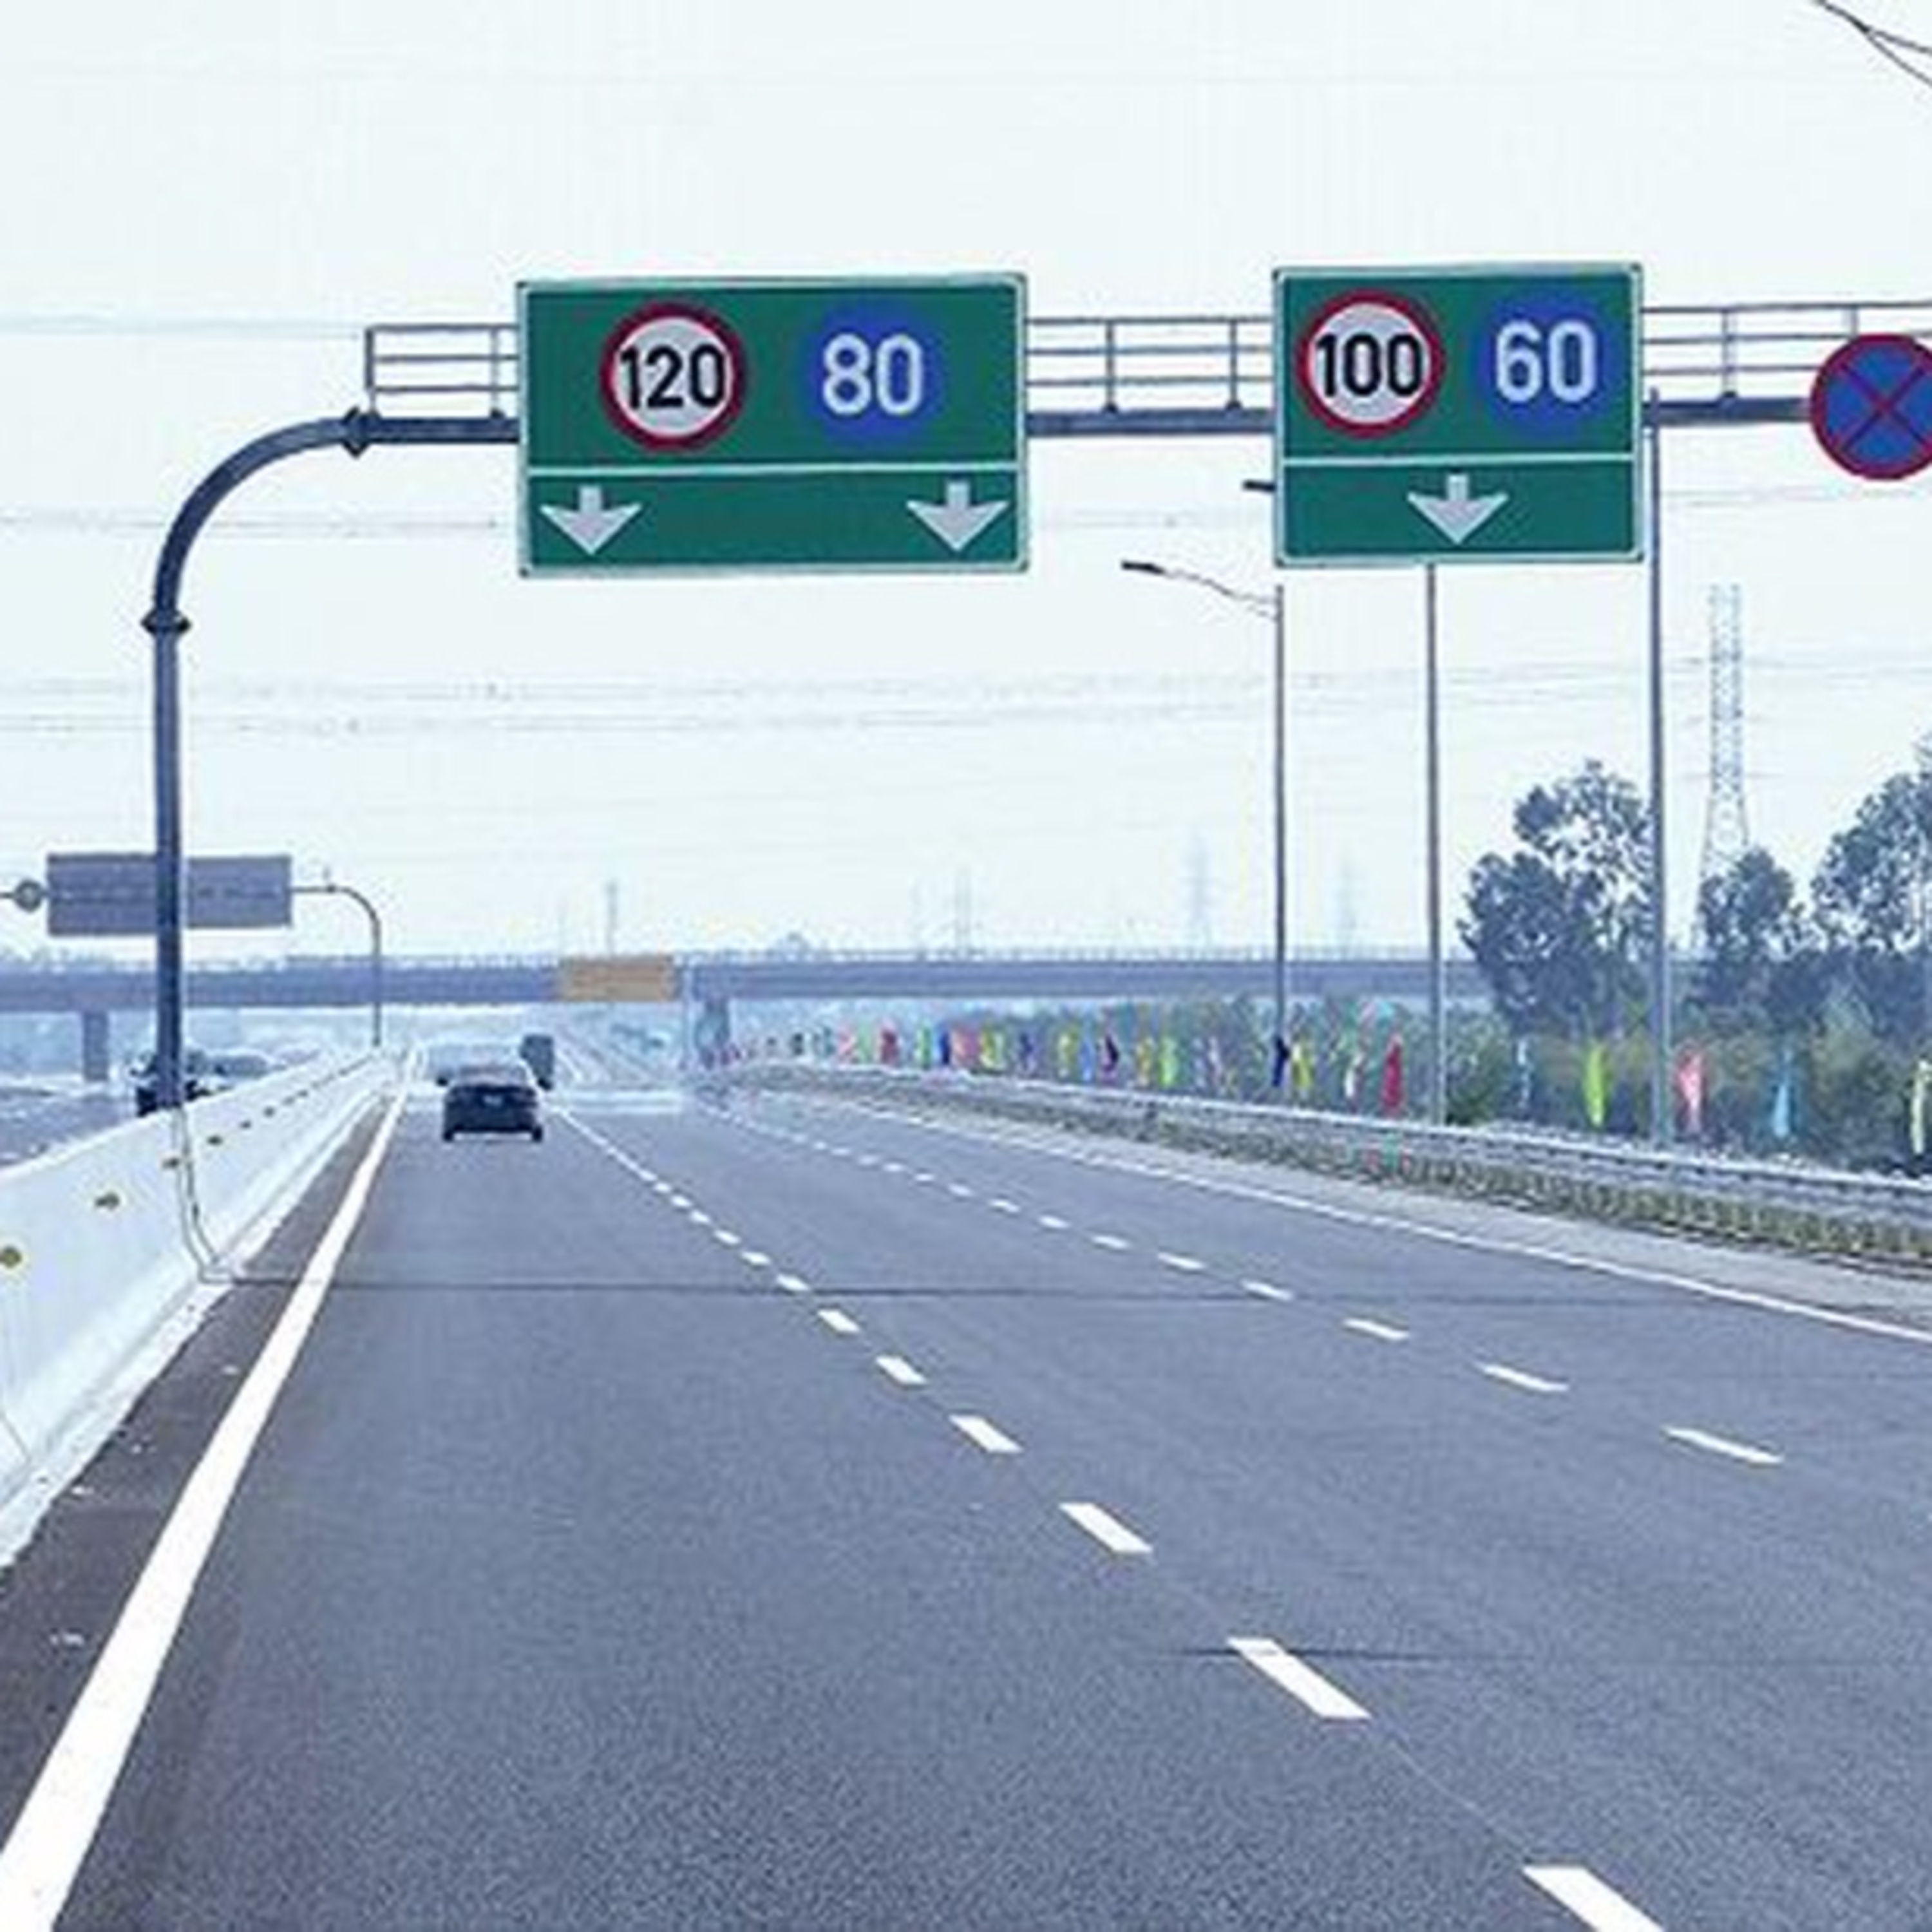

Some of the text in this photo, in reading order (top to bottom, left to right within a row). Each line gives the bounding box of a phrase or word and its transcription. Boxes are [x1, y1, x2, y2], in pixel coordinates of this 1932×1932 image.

[619, 344, 726, 410] 120
[822, 333, 925, 415] 80
[1316, 333, 1422, 397] 100
[1496, 321, 1597, 402] 60
